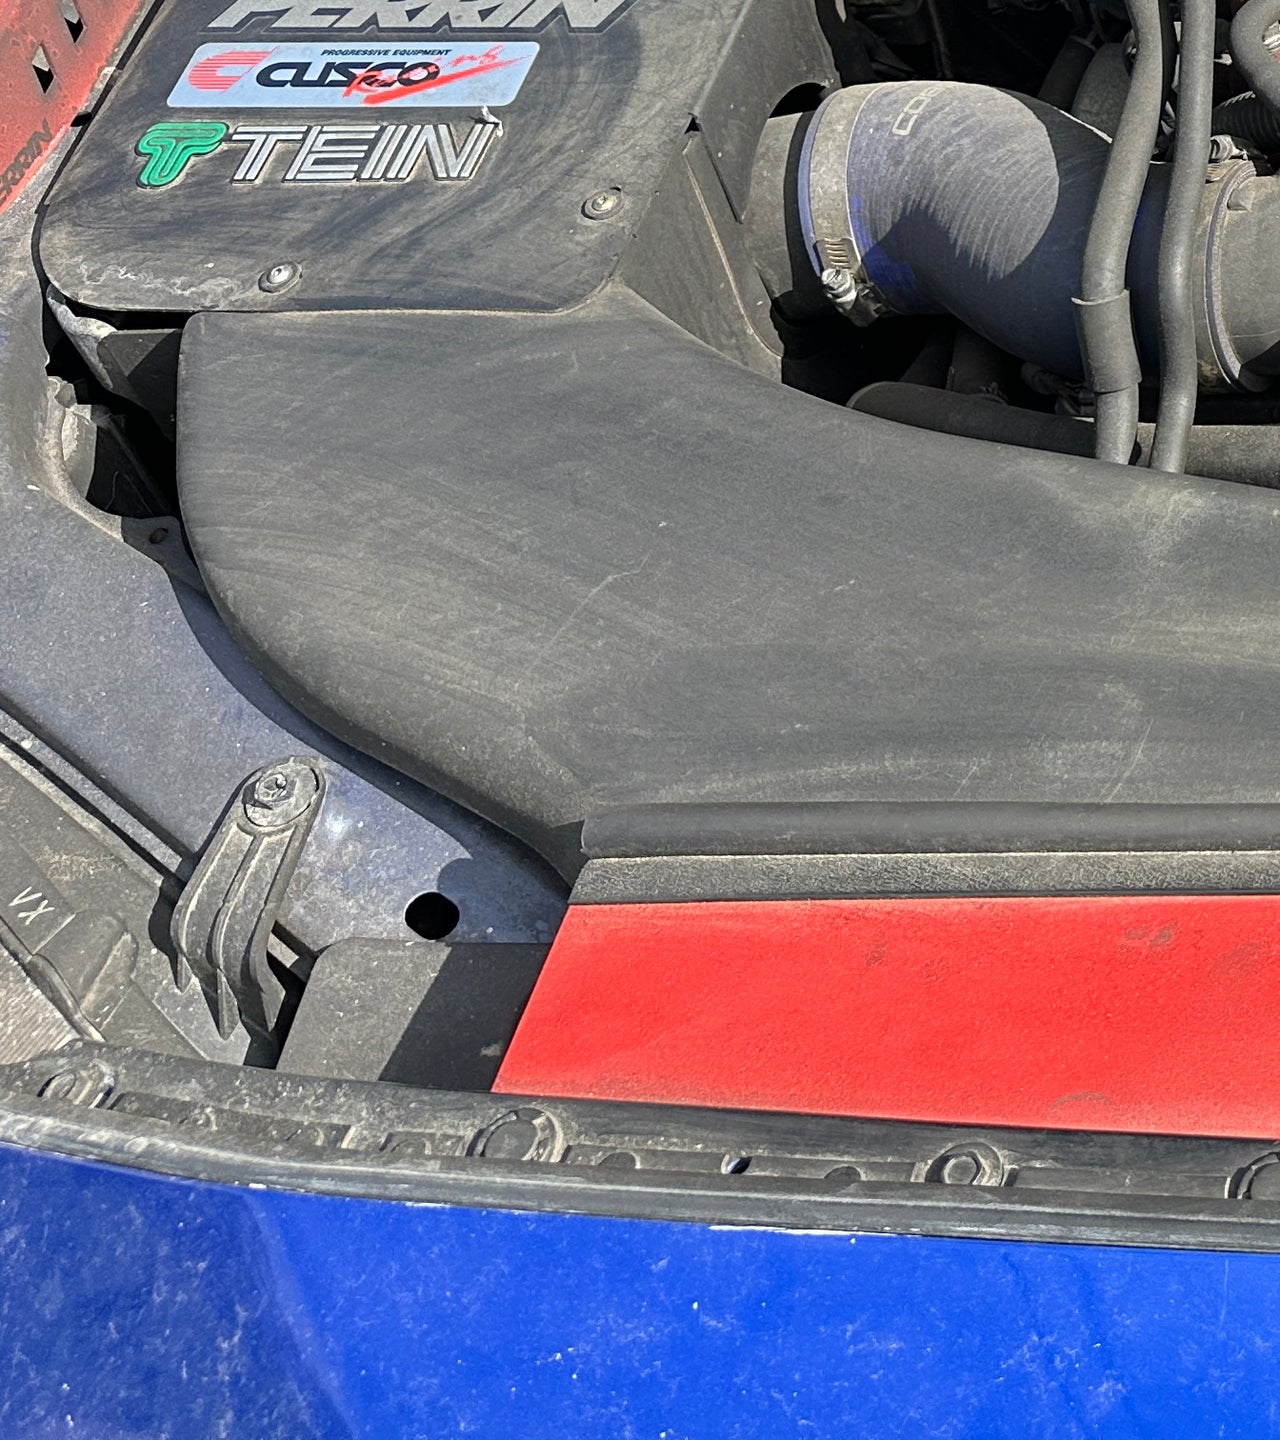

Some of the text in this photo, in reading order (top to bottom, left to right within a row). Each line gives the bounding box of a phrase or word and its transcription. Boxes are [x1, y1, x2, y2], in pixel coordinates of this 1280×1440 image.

[321, 49, 453, 57] PROGRESSIVE EQUIPMENT
[256, 61, 441, 88] CUSCO
[231, 124, 497, 183] TEIN
